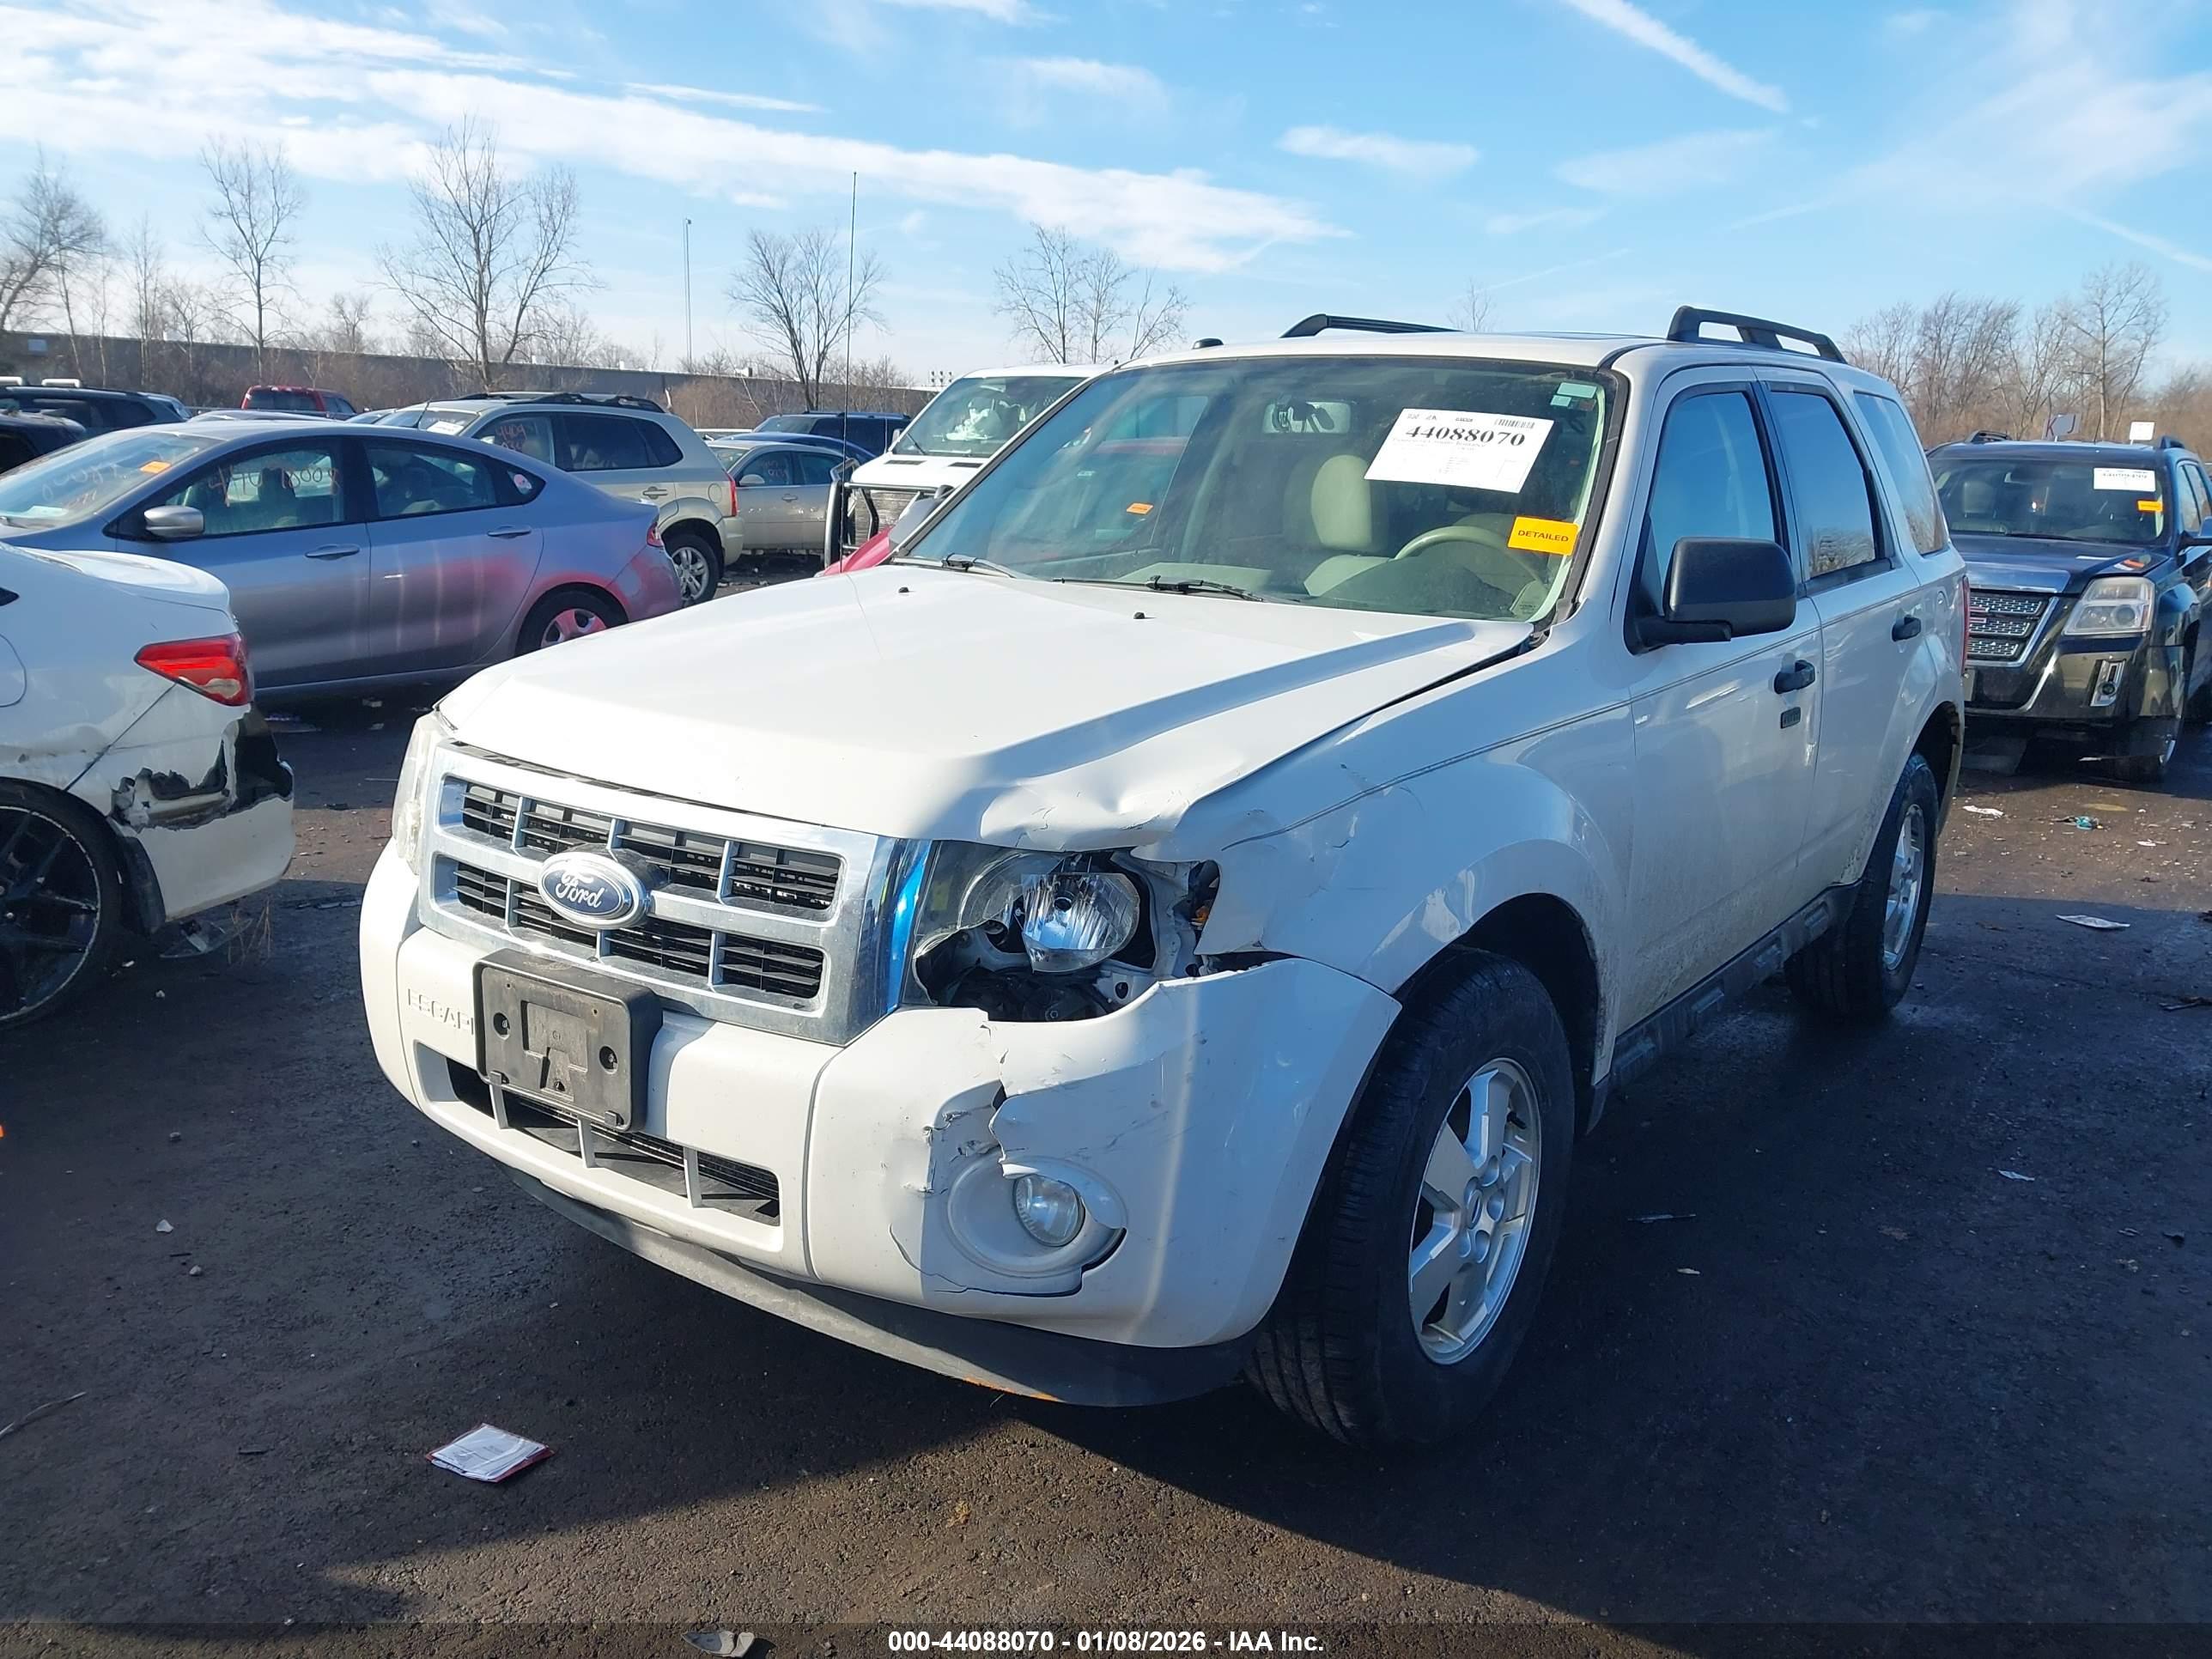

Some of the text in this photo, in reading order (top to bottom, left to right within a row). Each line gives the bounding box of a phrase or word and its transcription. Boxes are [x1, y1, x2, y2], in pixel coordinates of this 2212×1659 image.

[1406, 426, 1526, 447] 44088070
[1517, 530, 1570, 542] DETAILED
[555, 869, 605, 908] Ford
[408, 988, 474, 1036] ESCAP
